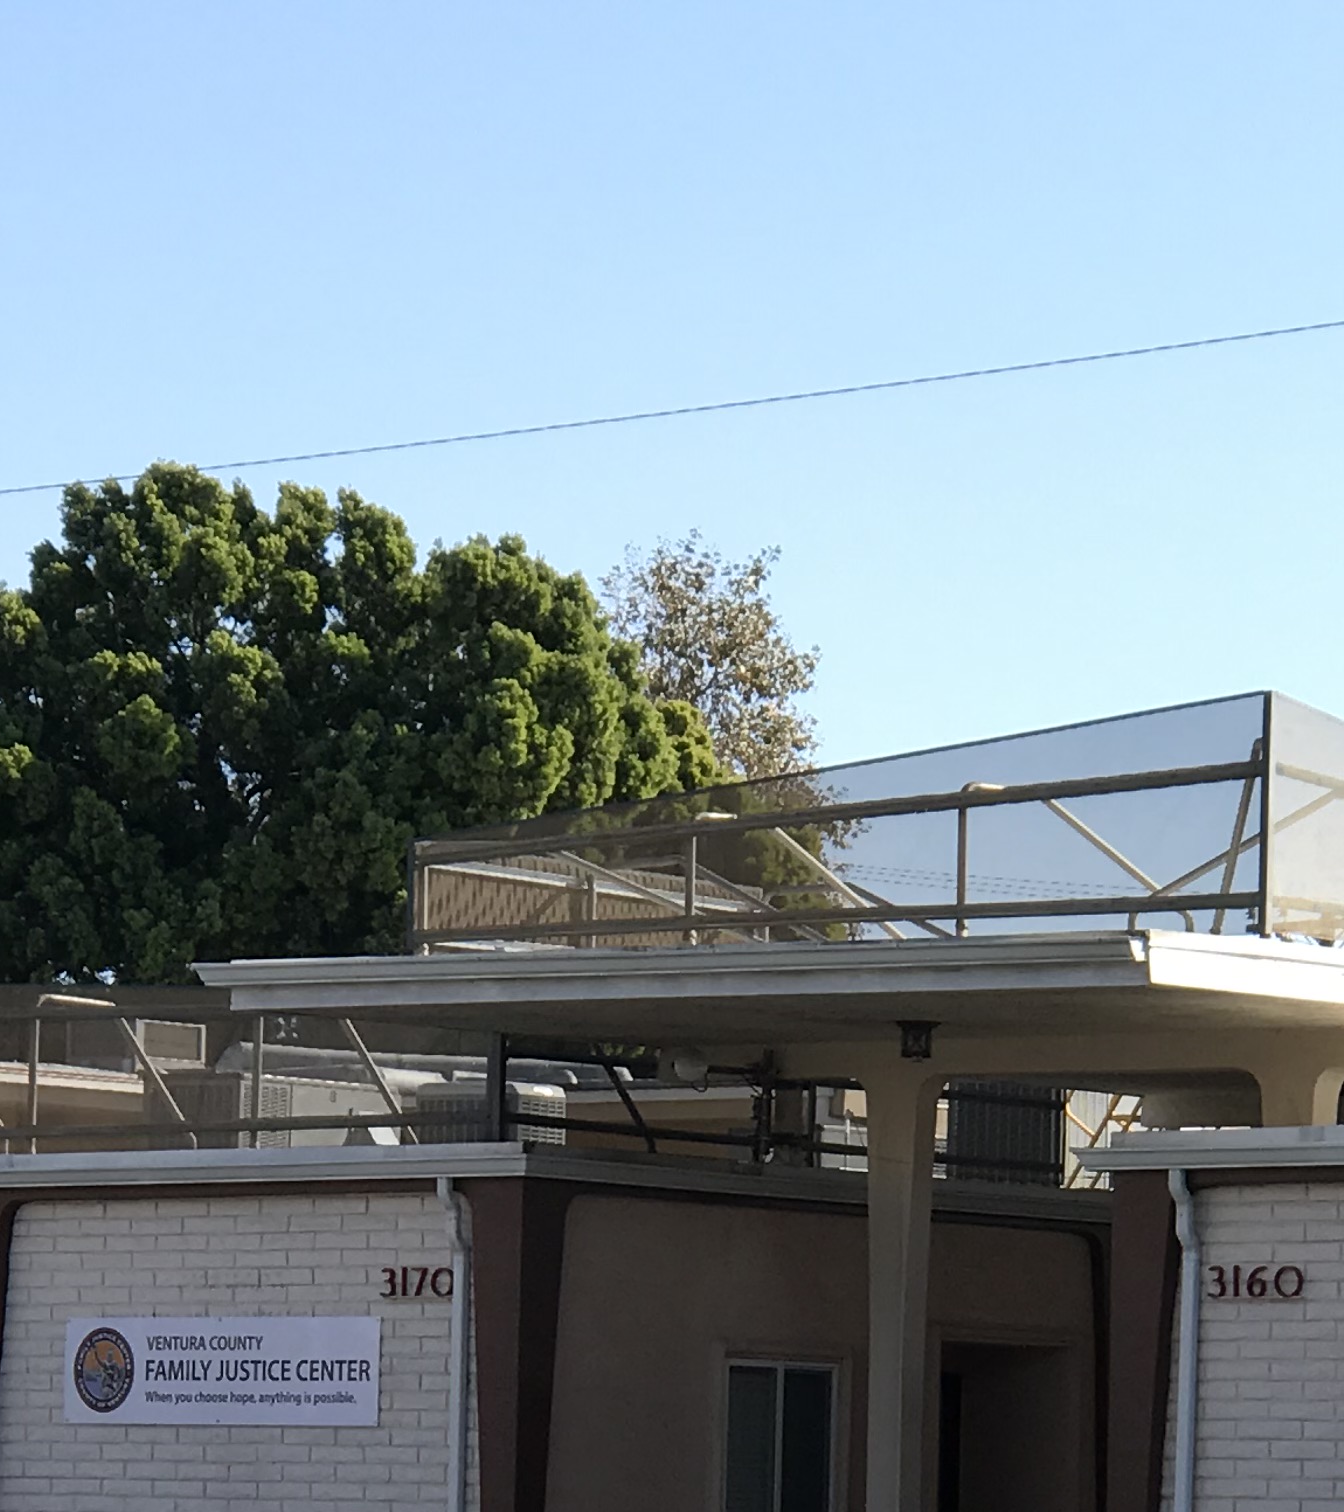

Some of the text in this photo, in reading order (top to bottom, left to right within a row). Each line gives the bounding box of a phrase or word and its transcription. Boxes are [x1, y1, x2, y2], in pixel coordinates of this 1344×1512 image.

[379, 1266, 454, 1298] 3170
[1207, 1265, 1305, 1298] 3160
[147, 1336, 263, 1351] VENTURA COUNTY
[145, 1360, 371, 1382] FAMILY JUSTICE CENTER
[145, 1391, 173, 1403] When
[175, 1394, 193, 1405] you
[195, 1391, 228, 1403] choose
[259, 1391, 302, 1406] anything
[304, 1391, 311, 1403] is
[313, 1391, 356, 1406] possible.
